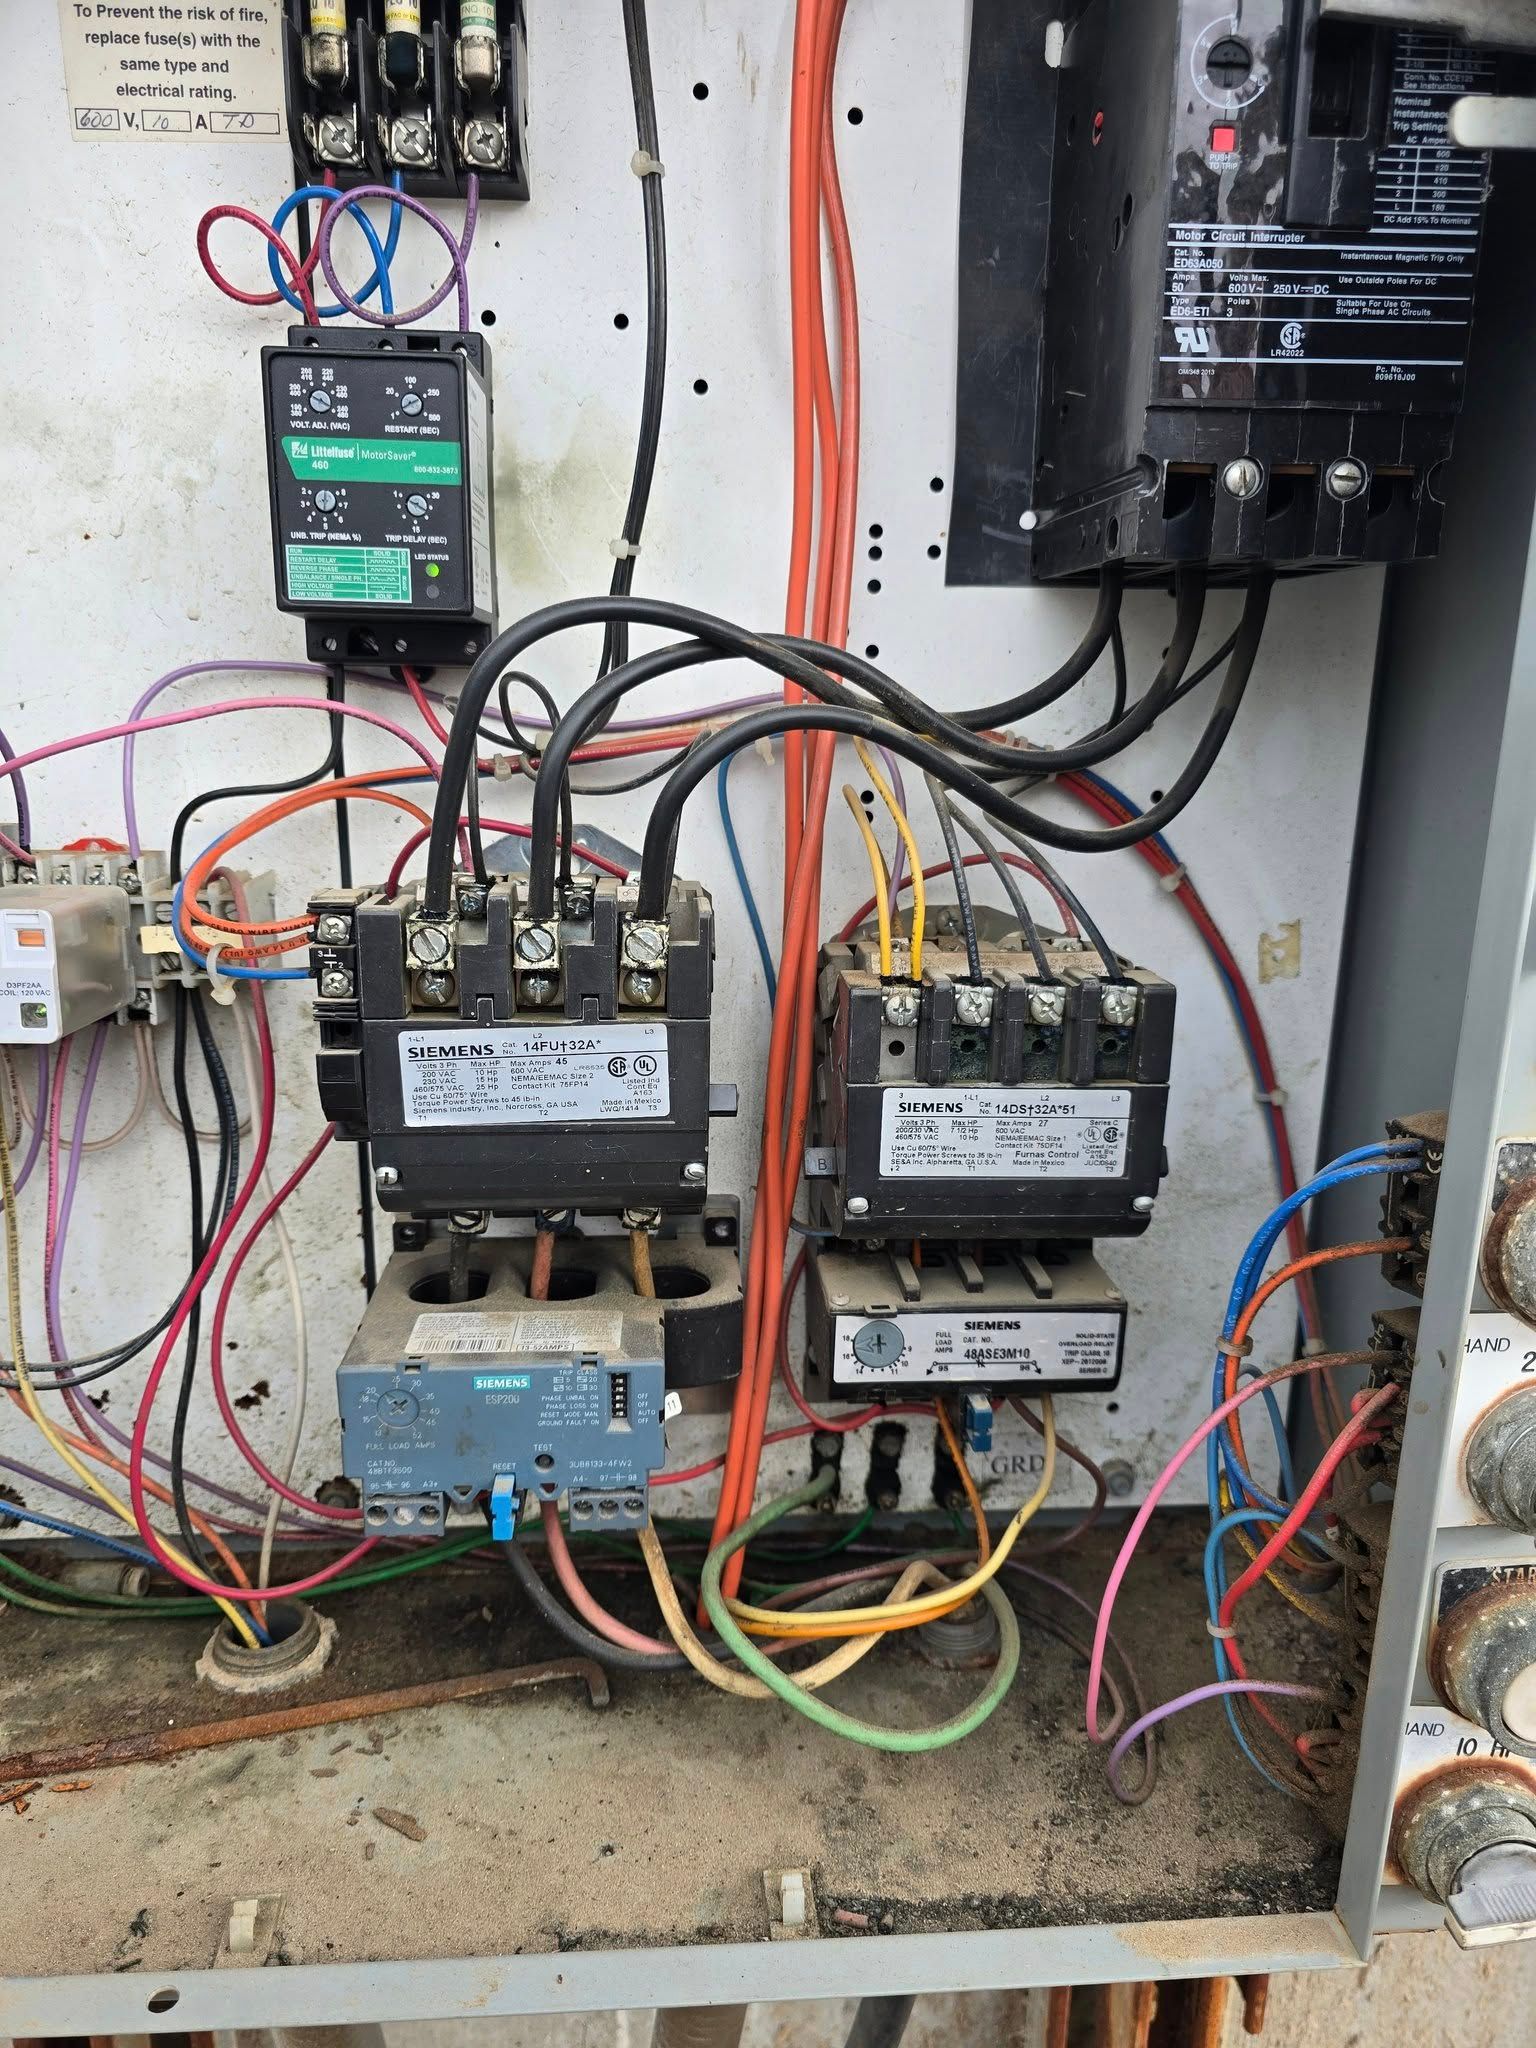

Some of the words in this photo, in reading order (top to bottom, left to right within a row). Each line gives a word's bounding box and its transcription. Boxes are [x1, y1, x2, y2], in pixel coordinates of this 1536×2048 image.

[74, 4, 92, 18] To
[97, 5, 154, 19] Prevent
[159, 6, 182, 19] the
[187, 7, 215, 20] risk
[220, 8, 234, 20] of
[240, 8, 268, 24] fire,
[86, 32, 140, 46] replace
[144, 32, 196, 49] fuse(s)
[201, 33, 232, 47] with
[237, 35, 260, 47] the
[120, 60, 160, 71] same
[165, 59, 197, 74] type
[202, 60, 229, 73] and
[116, 84, 184, 97] electrical
[189, 86, 236, 102] rating.
[1394, 98, 1431, 106] Nominal
[80, 109, 112, 127] 600
[124, 112, 139, 130] V,
[152, 115, 169, 129] 10
[195, 115, 207, 129] A
[1393, 121, 1409, 131] Trip
[1221, 162, 1238, 170] TRIP
[1440, 217, 1471, 225] Nominal
[1176, 230, 1206, 240] Motor
[1211, 231, 1245, 241] Circuit
[1251, 232, 1305, 244] Interrupter
[1341, 253, 1392, 261] Instantaneous
[1396, 254, 1428, 262] Magnetic
[1447, 255, 1464, 263] Only
[1174, 259, 1223, 268] ED63A050
[1172, 283, 1183, 292] 50
[1229, 284, 1246, 293] 600
[1273, 285, 1291, 293] 250
[1171, 307, 1209, 316] ED6-ETI
[1227, 308, 1232, 317] 3
[1336, 307, 1357, 316] Single
[330, 423, 350, 431] (VAC)
[385, 425, 418, 433] RESTART
[420, 427, 439, 435] (SEC)
[312, 461, 328, 469] 460
[291, 532, 308, 540] UNB.
[428, 536, 447, 545] (SEC)
[408, 1044, 494, 1058] SIEMENS
[511, 1074, 568, 1082] NEMA/EEMAC
[470, 1097, 499, 1105] Screws
[899, 1102, 963, 1113] SIEMENS
[818, 1159, 827, 1170] B
[964, 1321, 1021, 1331] SIEMENS
[964, 1348, 1030, 1360] 48ASE3M10
[476, 1379, 528, 1388] SIEMENS
[991, 1455, 1044, 1472] GRD
[1457, 1738, 1477, 1756] 10
